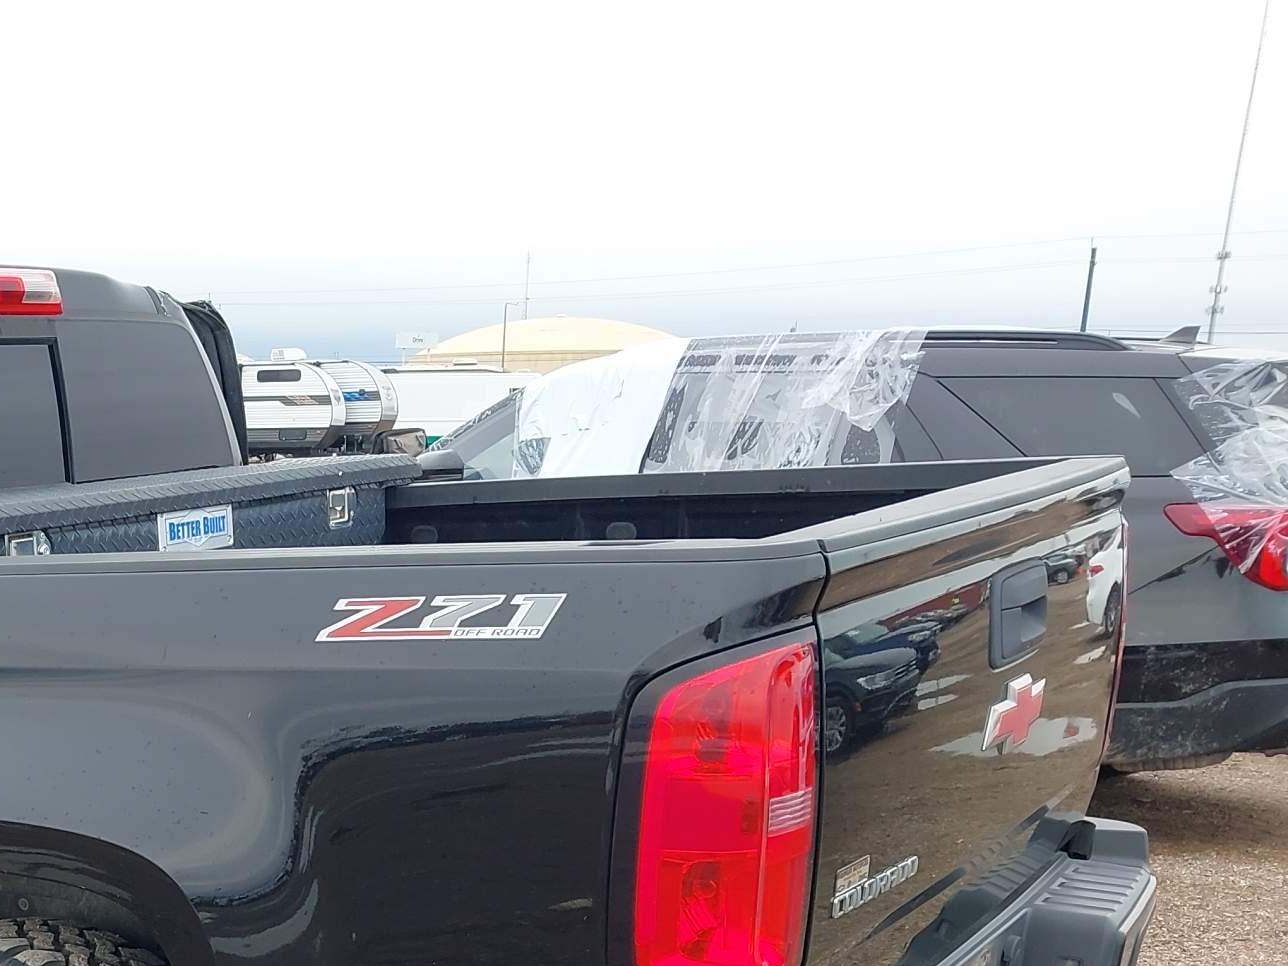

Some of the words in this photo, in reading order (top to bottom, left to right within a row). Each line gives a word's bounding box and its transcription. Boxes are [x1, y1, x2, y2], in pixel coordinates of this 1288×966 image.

[169, 520, 201, 541] BETTER
[203, 515, 226, 535] BUILT
[314, 593, 568, 642] Z71
[453, 629, 486, 638] OFF
[489, 628, 541, 638] ROAD
[832, 856, 919, 918] COLORADO
